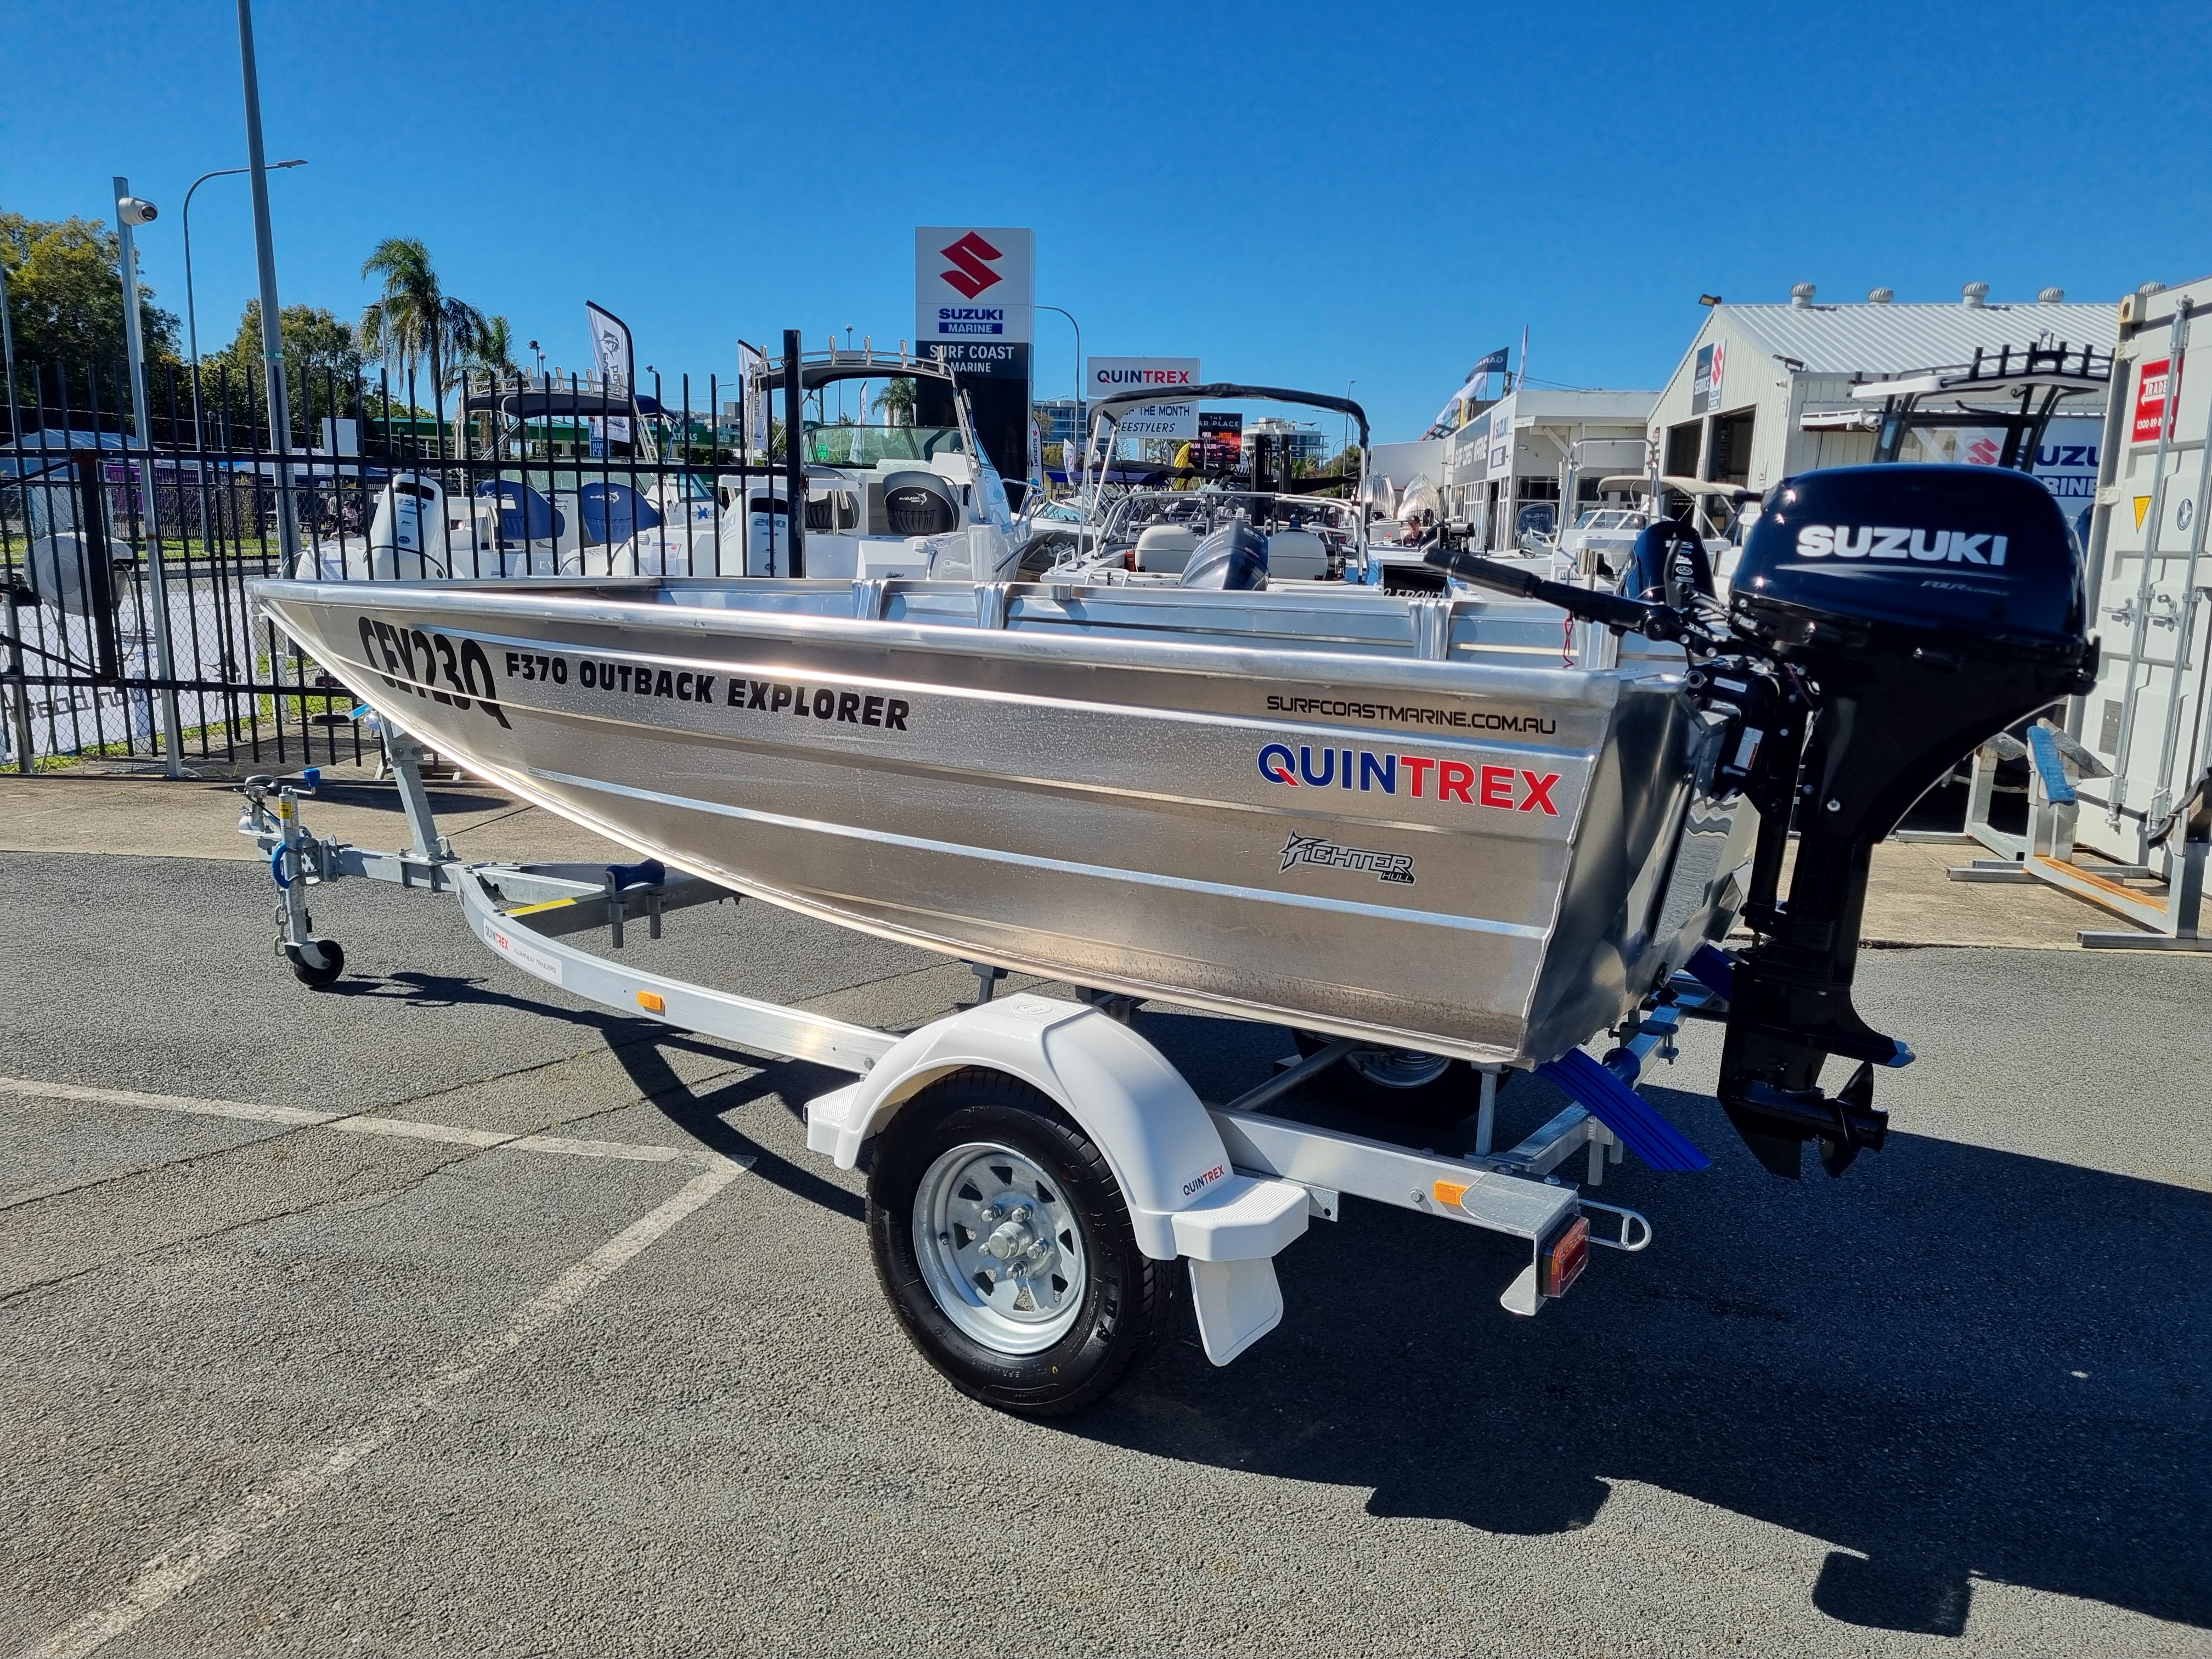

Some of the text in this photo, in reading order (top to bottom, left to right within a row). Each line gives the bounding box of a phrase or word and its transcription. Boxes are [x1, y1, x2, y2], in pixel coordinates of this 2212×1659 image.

[939, 308, 1003, 320] SUZUKI
[948, 324, 993, 333] MARINE
[929, 345, 1014, 359] SURF COAST
[950, 362, 991, 373] MARINE
[1097, 370, 1189, 384] QUINTREX
[2143, 379, 2168, 397] TRADE
[1140, 405, 1155, 416] THE
[1159, 406, 1189, 416] MONTH
[2043, 477, 2097, 495] RINE
[1797, 525, 2008, 566] SUZUKI
[505, 652, 910, 731] F370 OUTBACK EXPLORER
[1267, 696, 1556, 735] SURFCOASTMARINE.COM.AU
[1257, 743, 1562, 817] QUINTREX
[1382, 872, 1412, 882] HULL
[485, 925, 509, 951] QUINTREX
[535, 960, 557, 973] TRAILERS
[1183, 1164, 1224, 1196] QUINTREX
